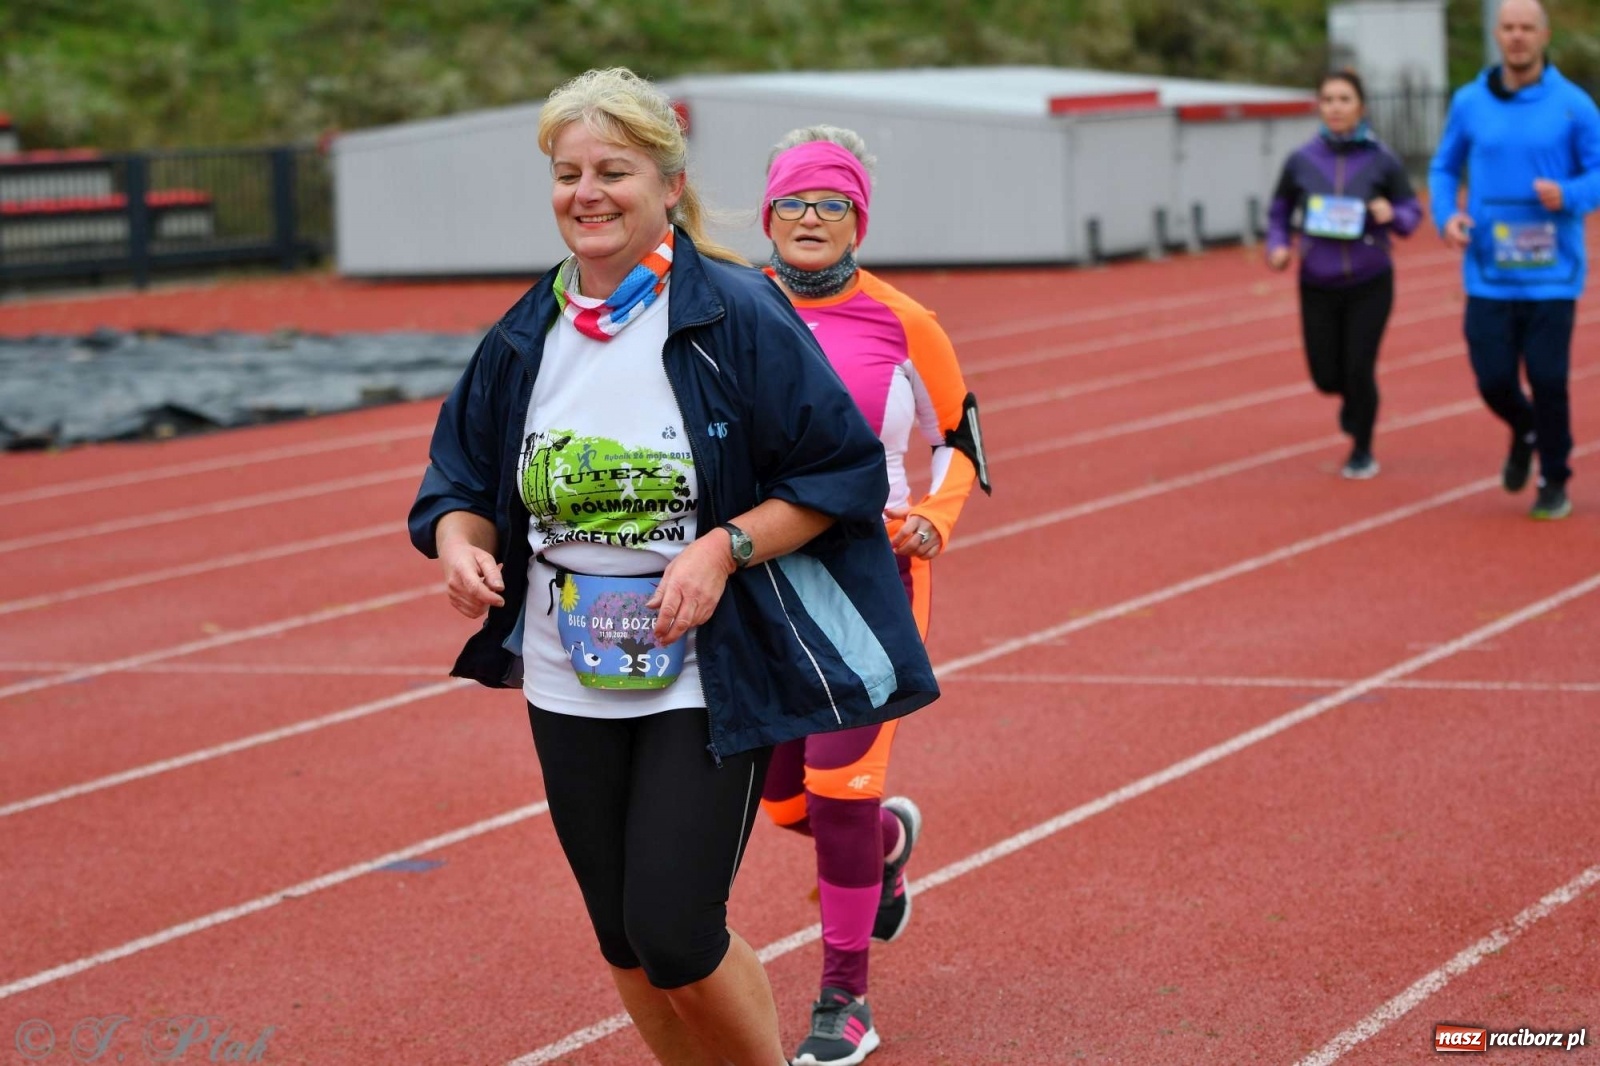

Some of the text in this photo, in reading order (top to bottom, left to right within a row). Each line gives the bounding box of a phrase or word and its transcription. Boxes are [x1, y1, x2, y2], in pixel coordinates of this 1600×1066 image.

[633, 452, 644, 460] 26
[646, 452, 668, 461] maja
[670, 451, 691, 460] 2013
[570, 497, 698, 516] PÓŁMARATON
[568, 614, 587, 628] BIEG
[591, 617, 614, 630] DLA
[619, 653, 670, 677] 259
[847, 774, 872, 790] 4F
